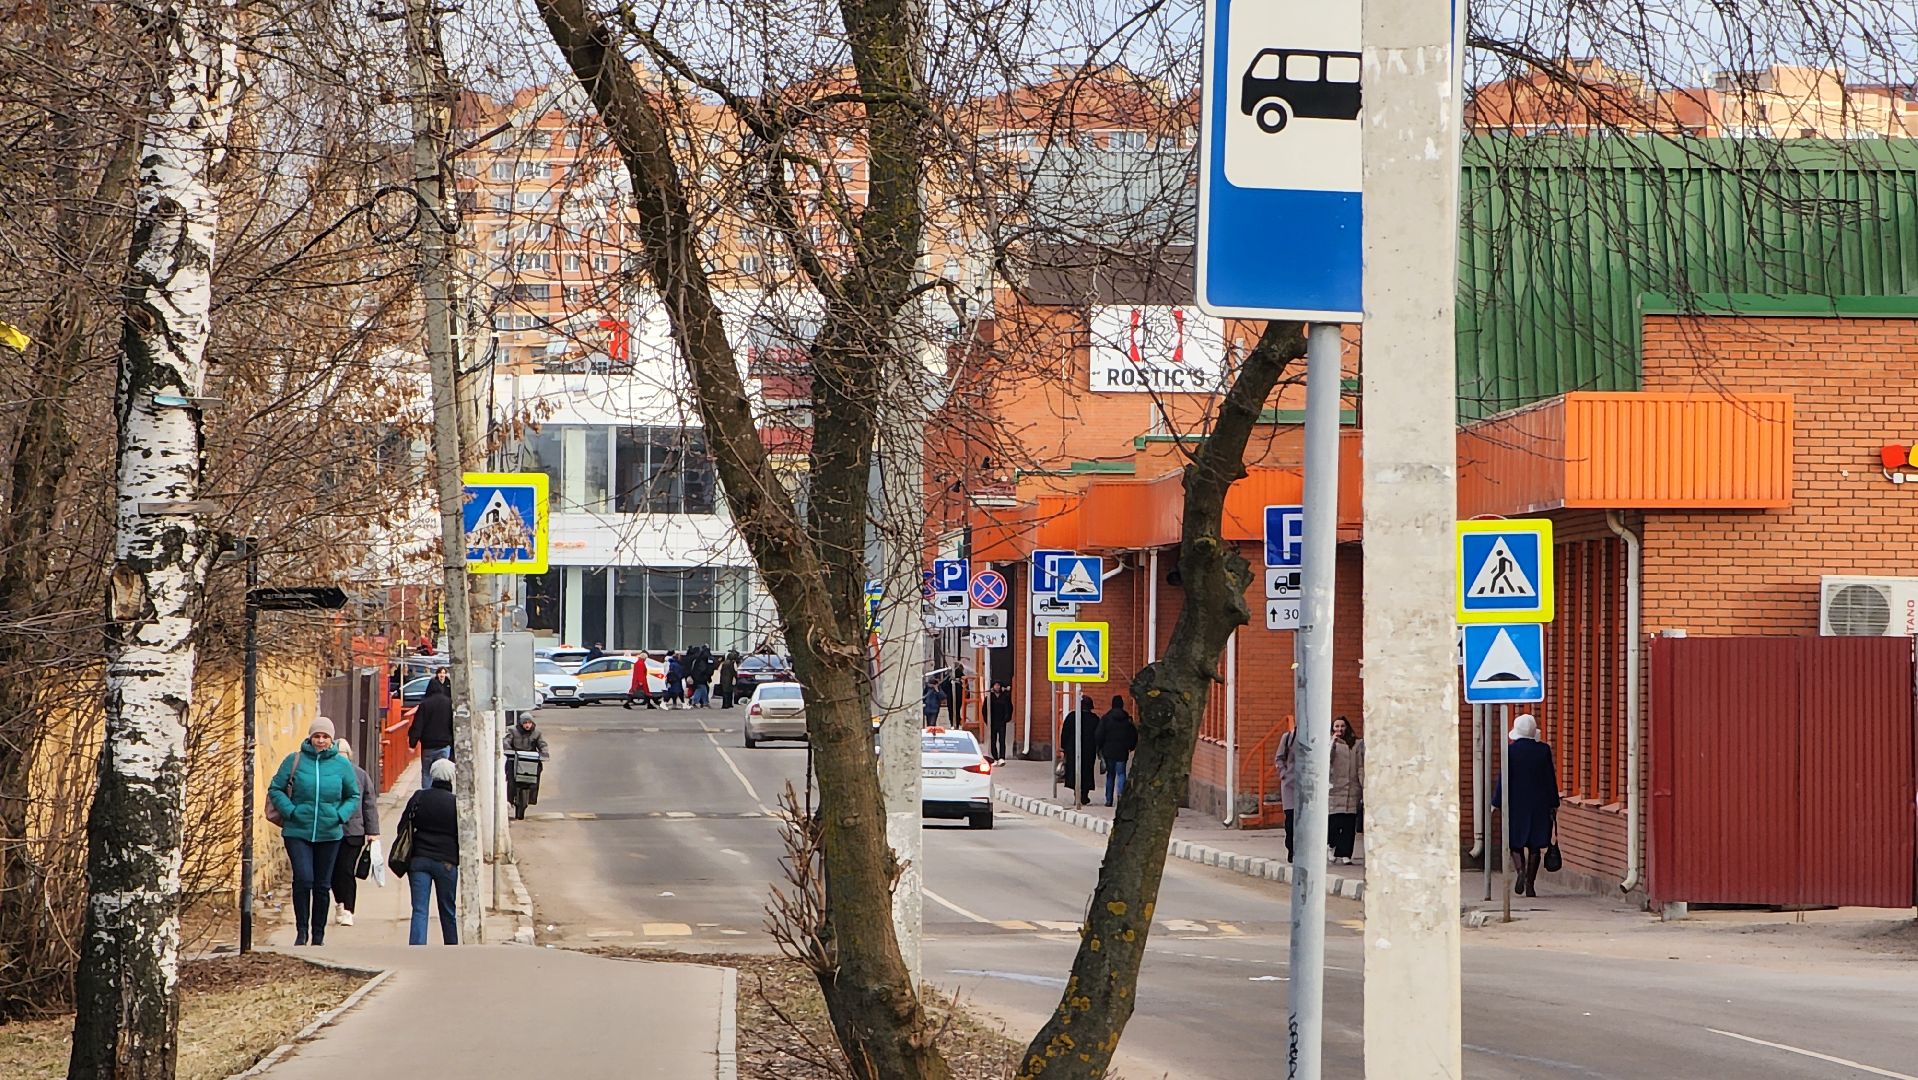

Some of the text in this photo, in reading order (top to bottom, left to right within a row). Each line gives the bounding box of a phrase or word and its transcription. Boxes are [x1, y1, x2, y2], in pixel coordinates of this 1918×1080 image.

[1107, 368, 1205, 387] ROSTIC'S
[944, 563, 962, 589] P
[1284, 609, 1299, 620] 30
